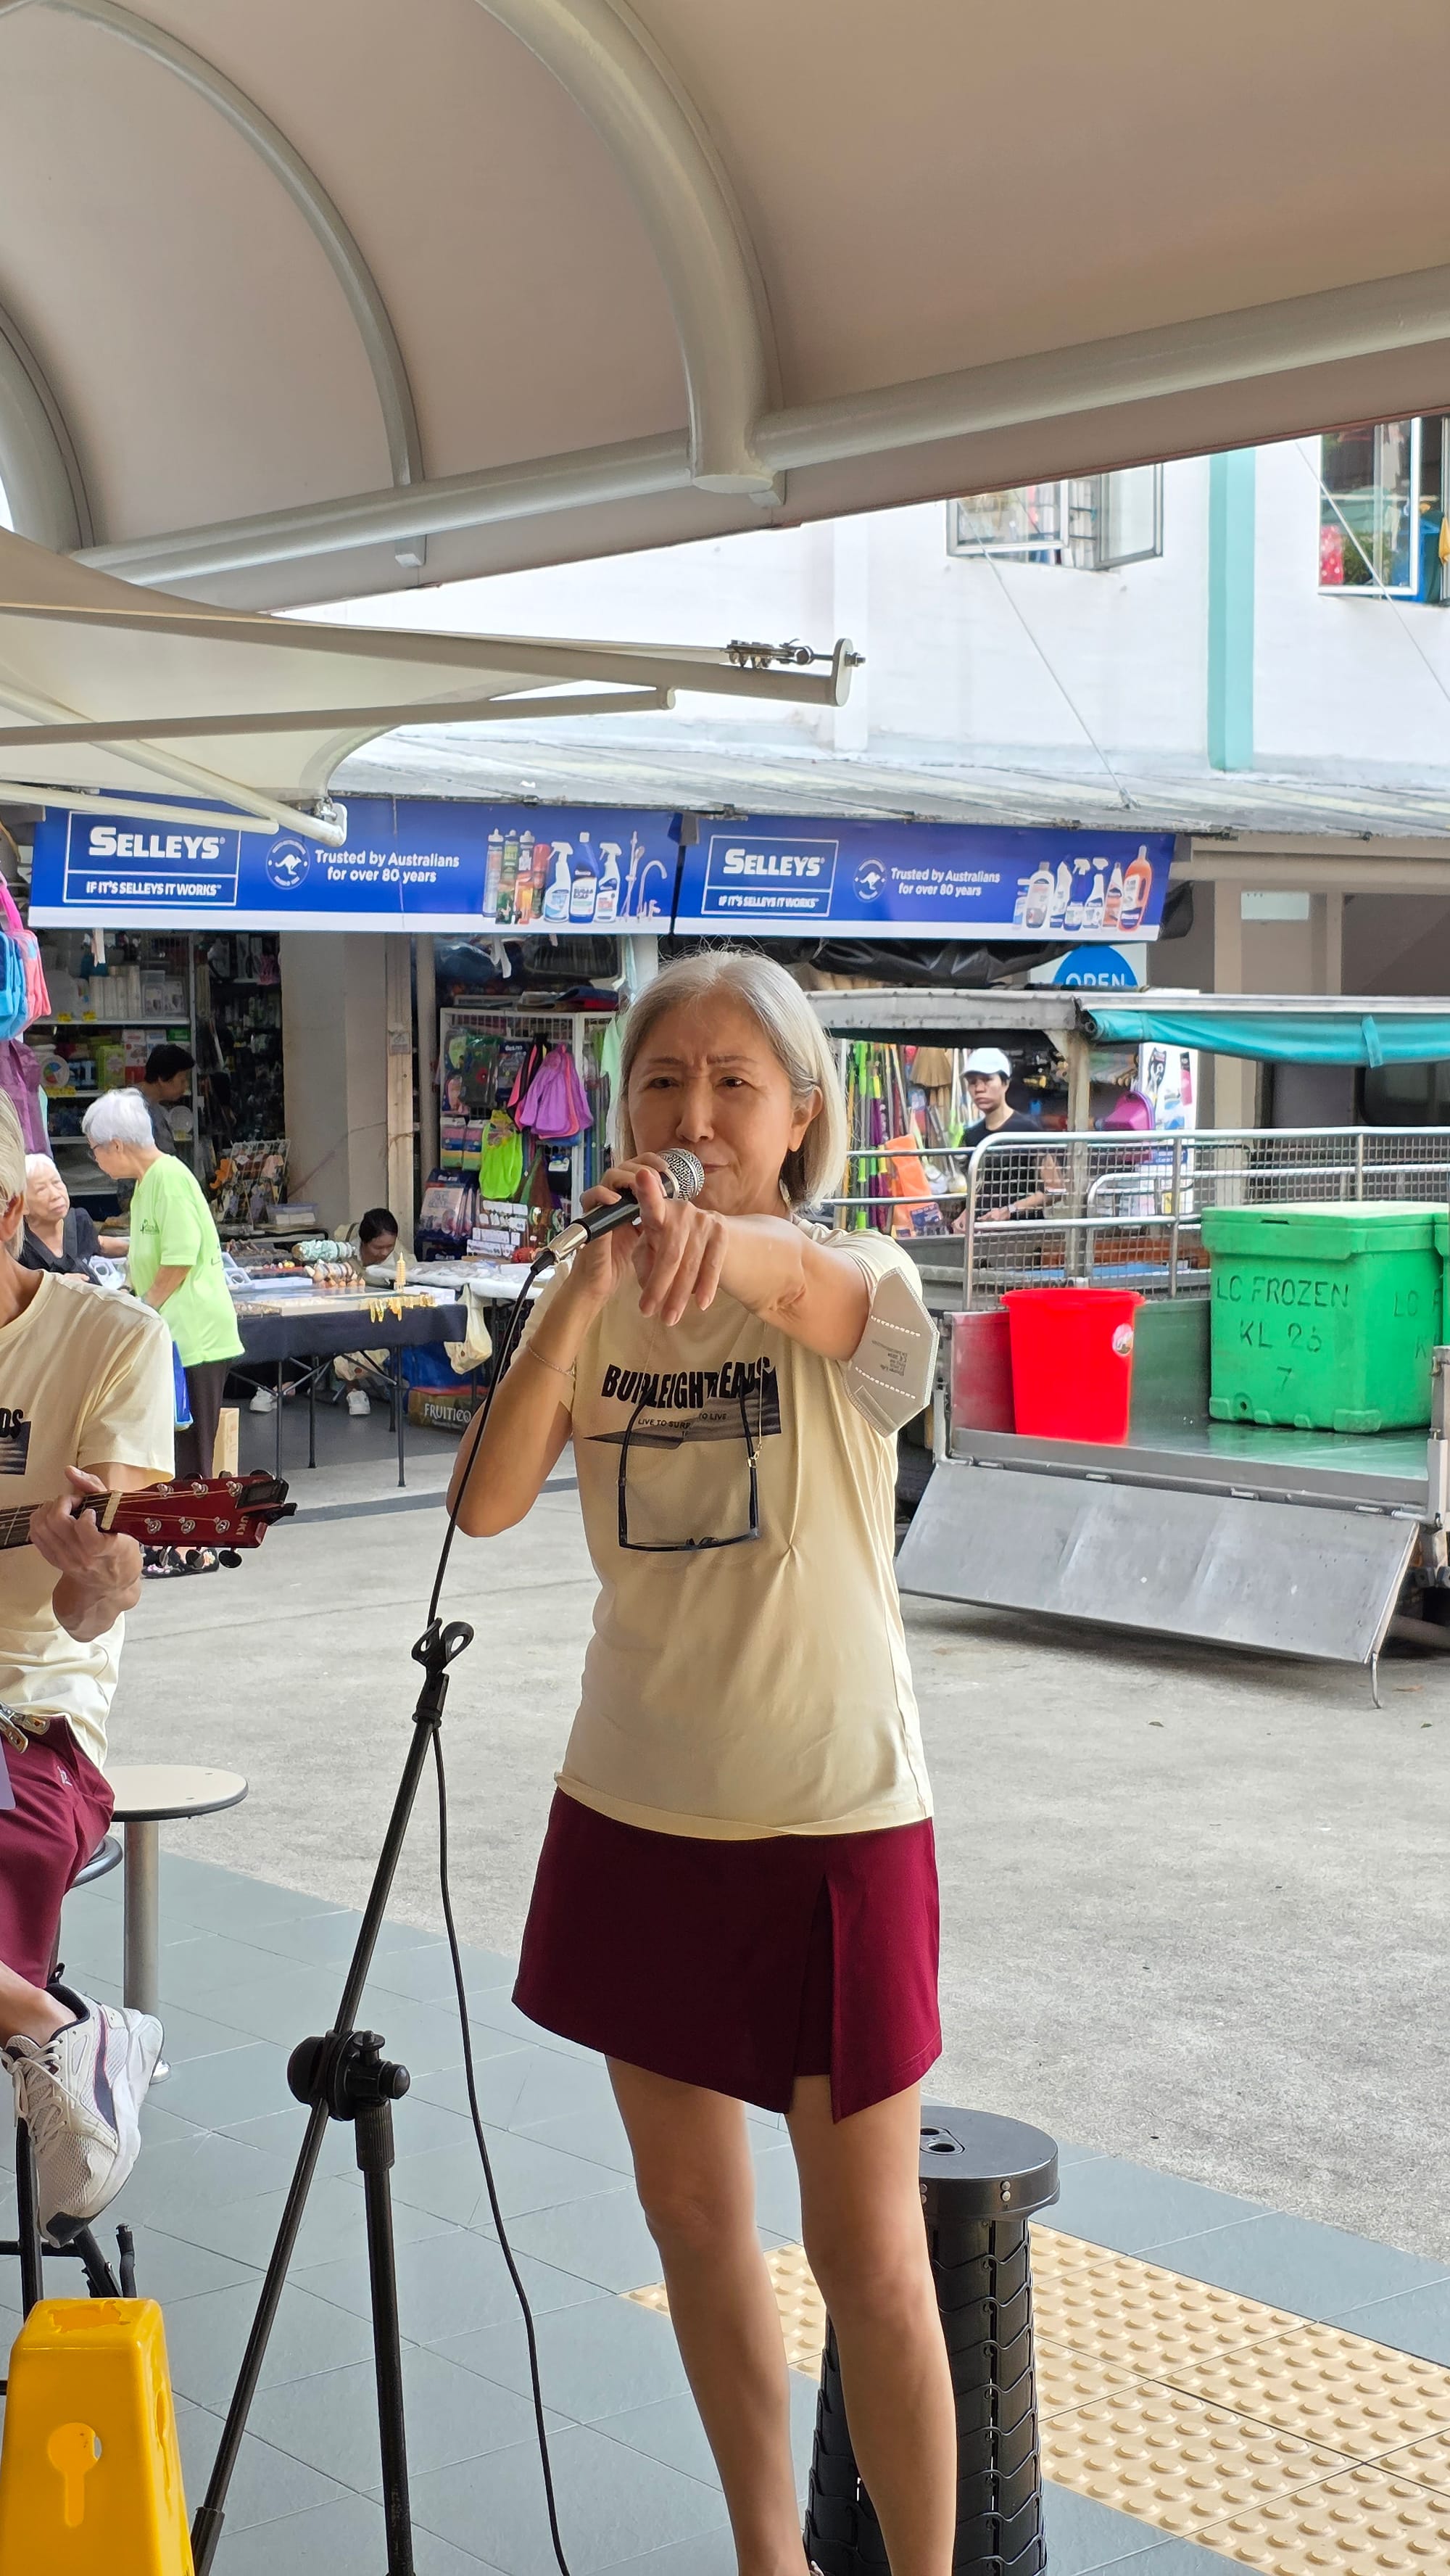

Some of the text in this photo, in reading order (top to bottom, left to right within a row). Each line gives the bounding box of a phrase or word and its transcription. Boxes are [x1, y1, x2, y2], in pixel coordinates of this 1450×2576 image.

[88, 825, 220, 859] SELLEYS
[315, 849, 460, 867] Trusted by Australians
[724, 848, 821, 877] SELLEYS
[86, 880, 218, 896] IF IT'S SELLEYS IT WORKS
[327, 867, 437, 884] for over 80 years
[891, 867, 1000, 883] Trusted by Australians
[898, 883, 982, 898] for over 80 years
[1217, 1274, 1349, 1308] LC FROZEN
[1240, 1319, 1273, 1349] KL
[601, 1363, 705, 1409] BURLEIGH
[1277, 1366, 1293, 1394] 7
